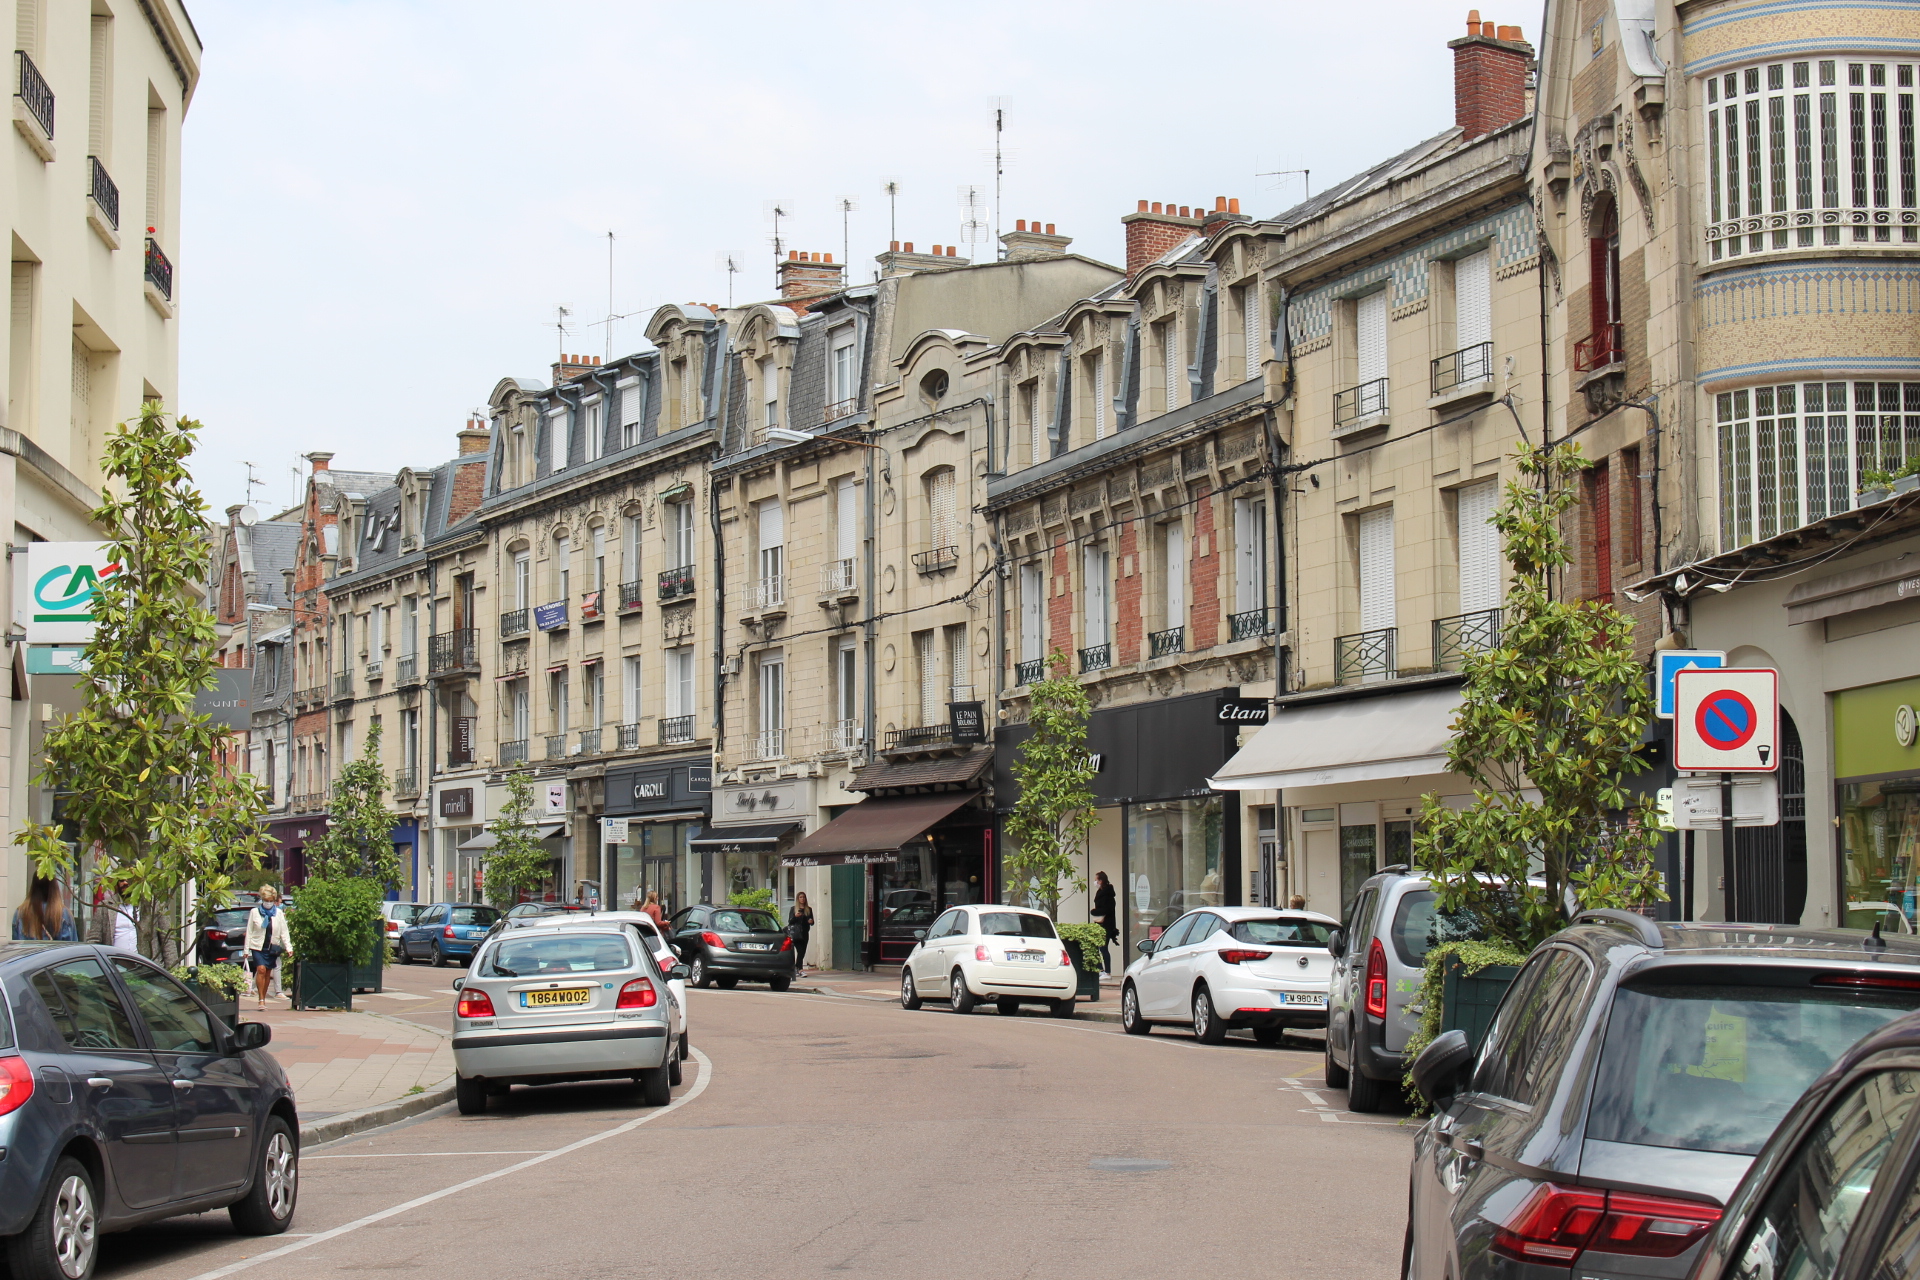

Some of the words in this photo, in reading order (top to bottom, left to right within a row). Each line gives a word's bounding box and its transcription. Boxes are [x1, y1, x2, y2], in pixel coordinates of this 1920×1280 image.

[956, 711, 963, 720] LE
[963, 710, 977, 719] PAIN
[1219, 703, 1266, 719] Etam
[957, 719, 978, 727] BOULANGER
[458, 720, 468, 752] minelli
[634, 782, 665, 799] CAROLL
[445, 794, 466, 814] minelli
[591, 888, 597, 897] P
